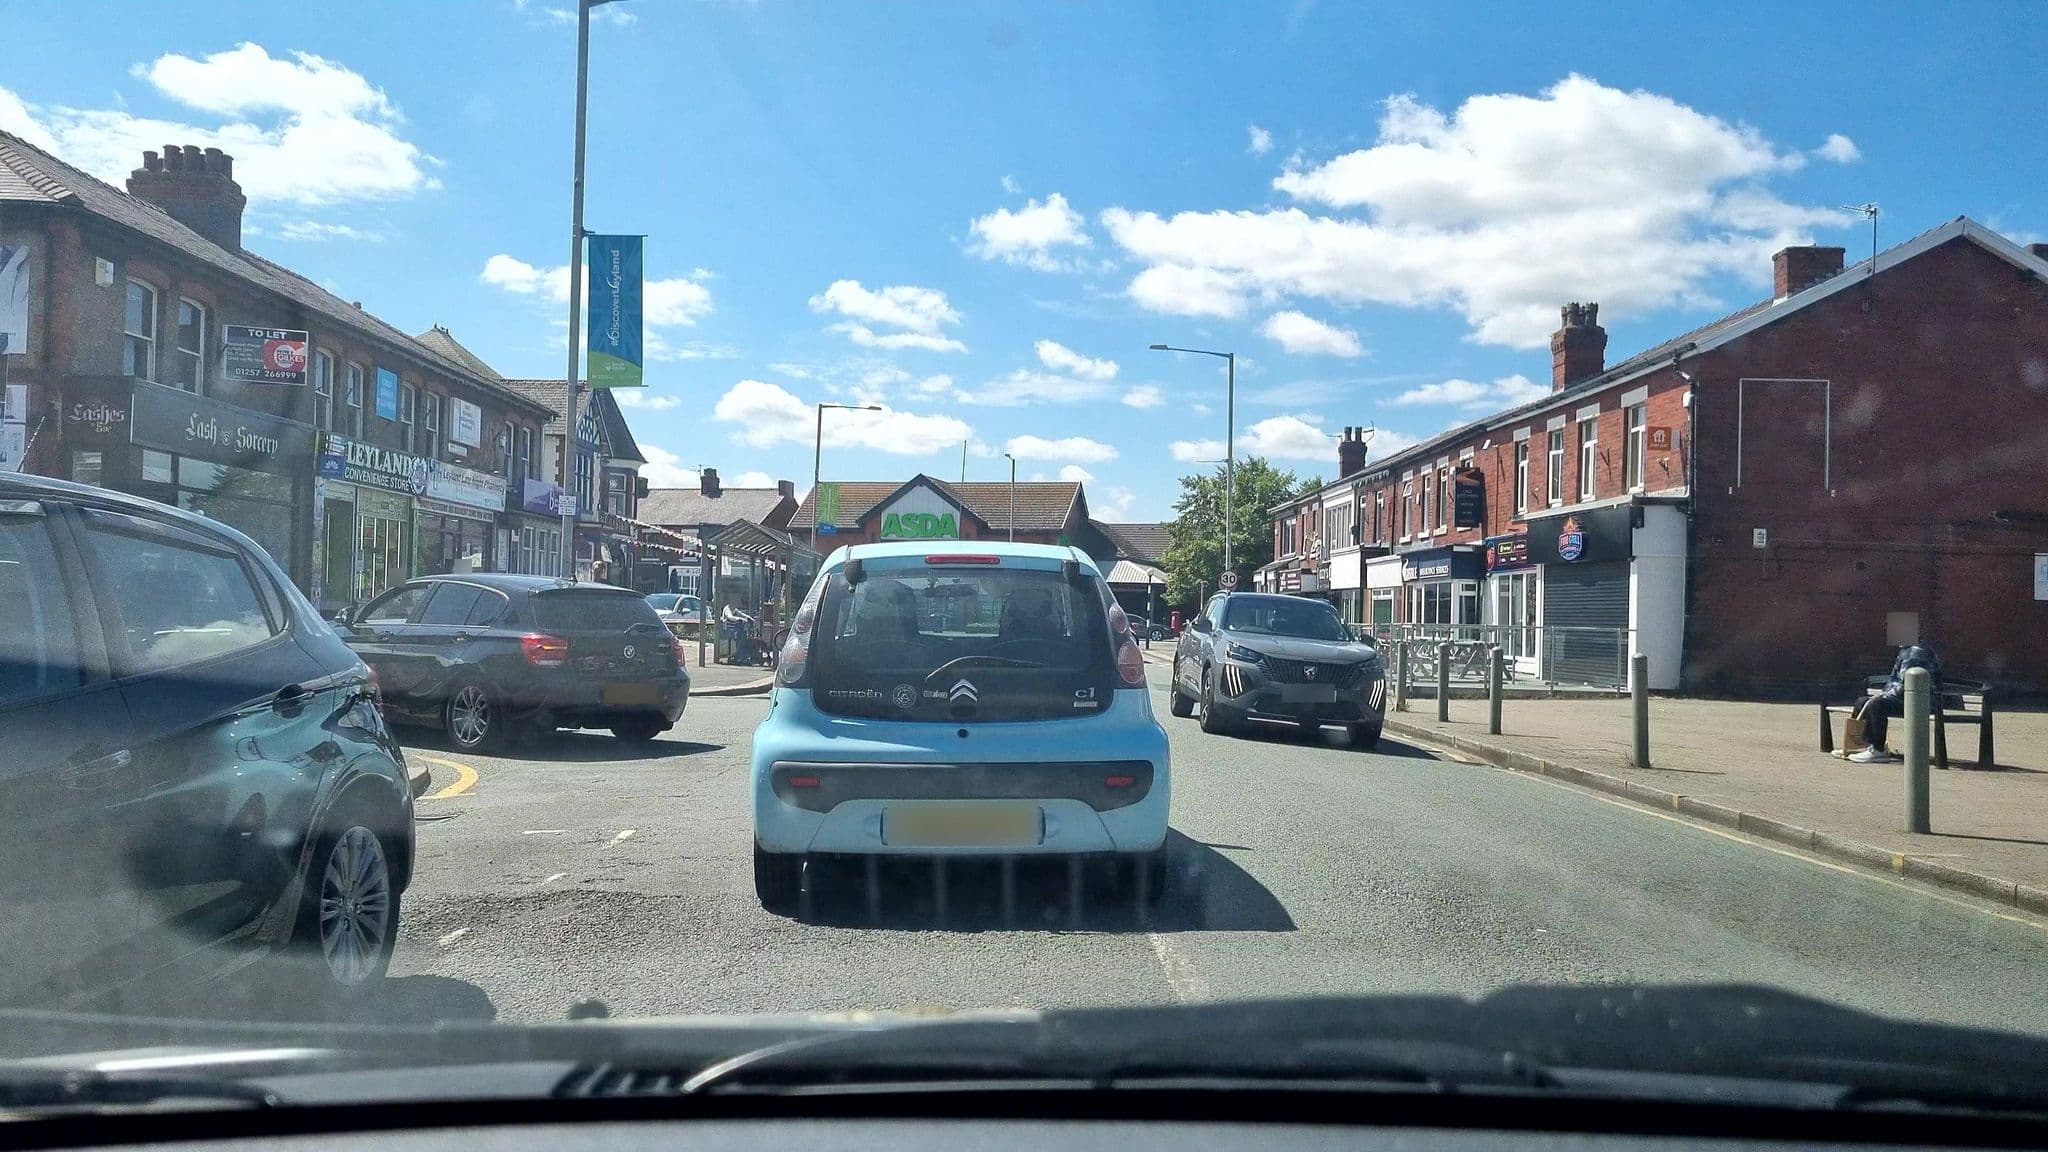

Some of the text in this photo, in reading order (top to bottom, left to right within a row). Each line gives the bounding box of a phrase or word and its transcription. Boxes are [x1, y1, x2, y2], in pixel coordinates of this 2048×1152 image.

[247, 328, 287, 339] TO LET
[235, 367, 297, 379] 01257 266999
[184, 412, 217, 447] Lash
[234, 425, 279, 460] Sorcery
[345, 441, 412, 477] LEYLAND
[344, 466, 410, 492] CONVENIENCE STORE
[881, 513, 958, 538] ASDA
[1222, 575, 1236, 584] 30
[1075, 687, 1095, 698] C1
